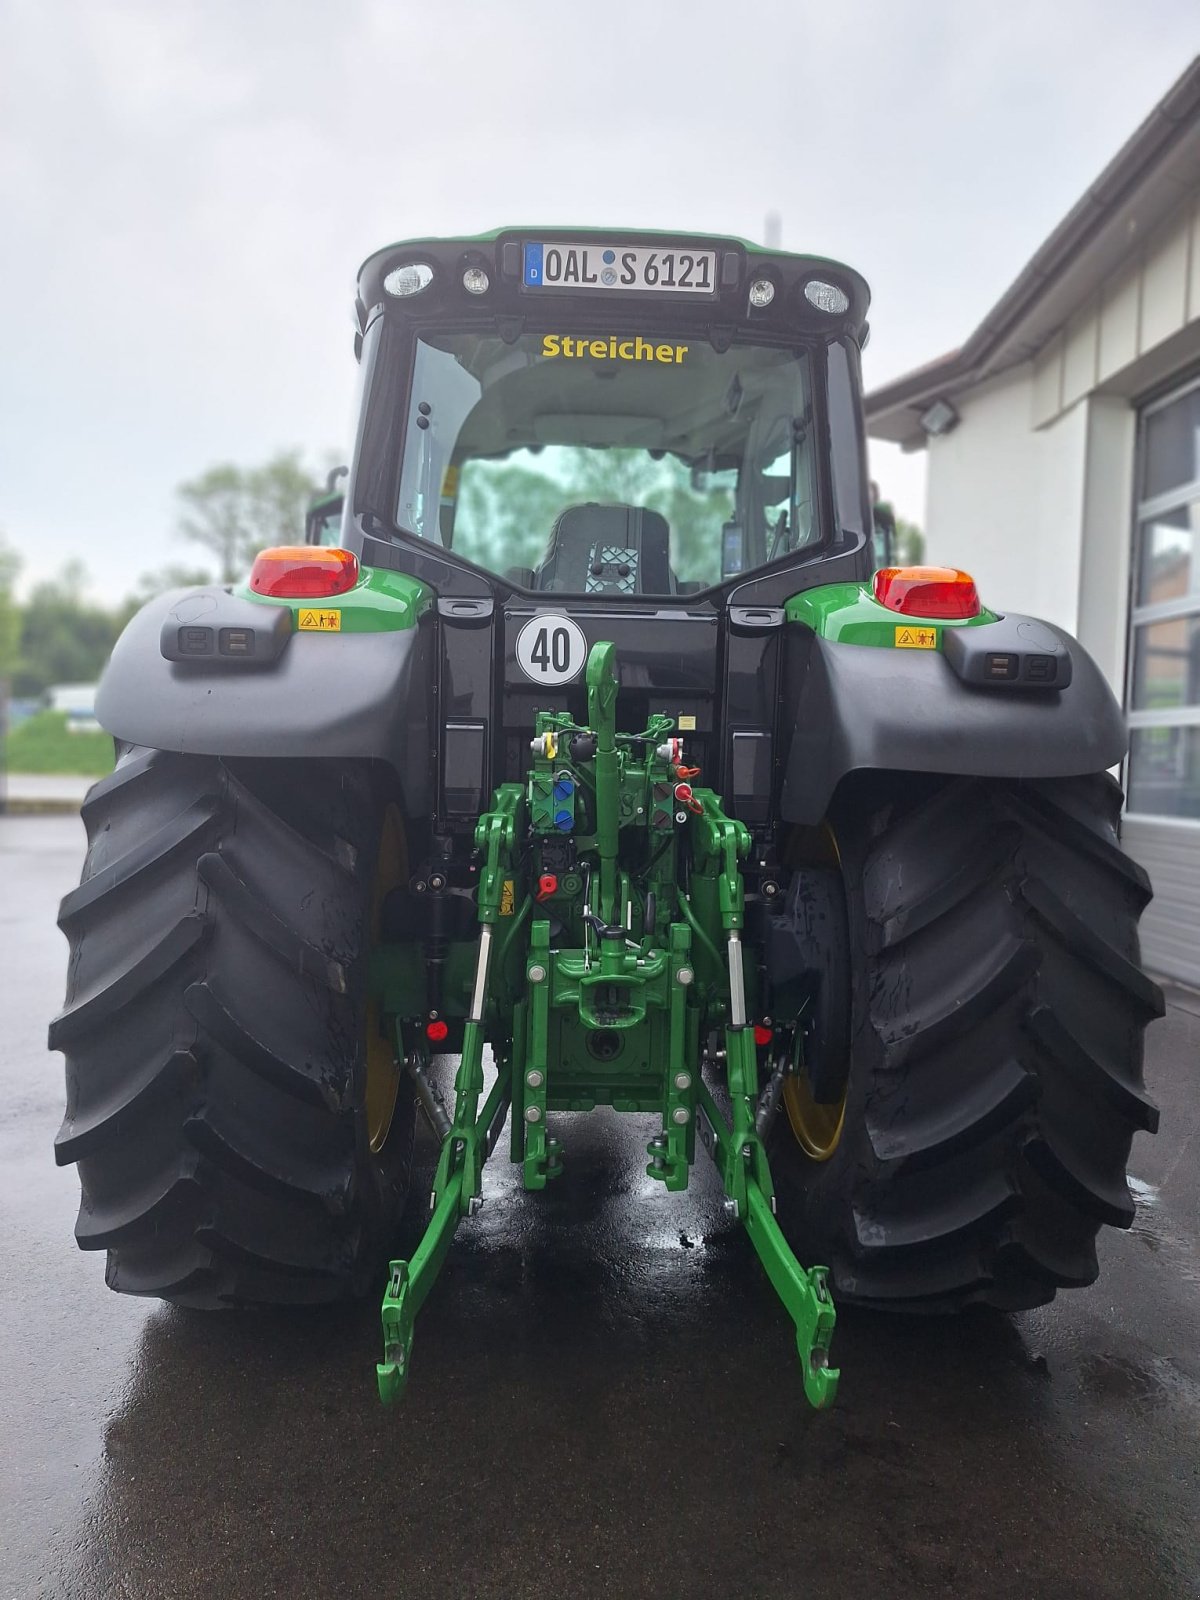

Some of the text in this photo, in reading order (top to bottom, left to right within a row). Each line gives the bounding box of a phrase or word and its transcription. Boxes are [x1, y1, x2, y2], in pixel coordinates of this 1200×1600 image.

[530, 249, 711, 288] D OAL S 6121
[542, 334, 689, 363] Streicher
[530, 626, 571, 673] 40
